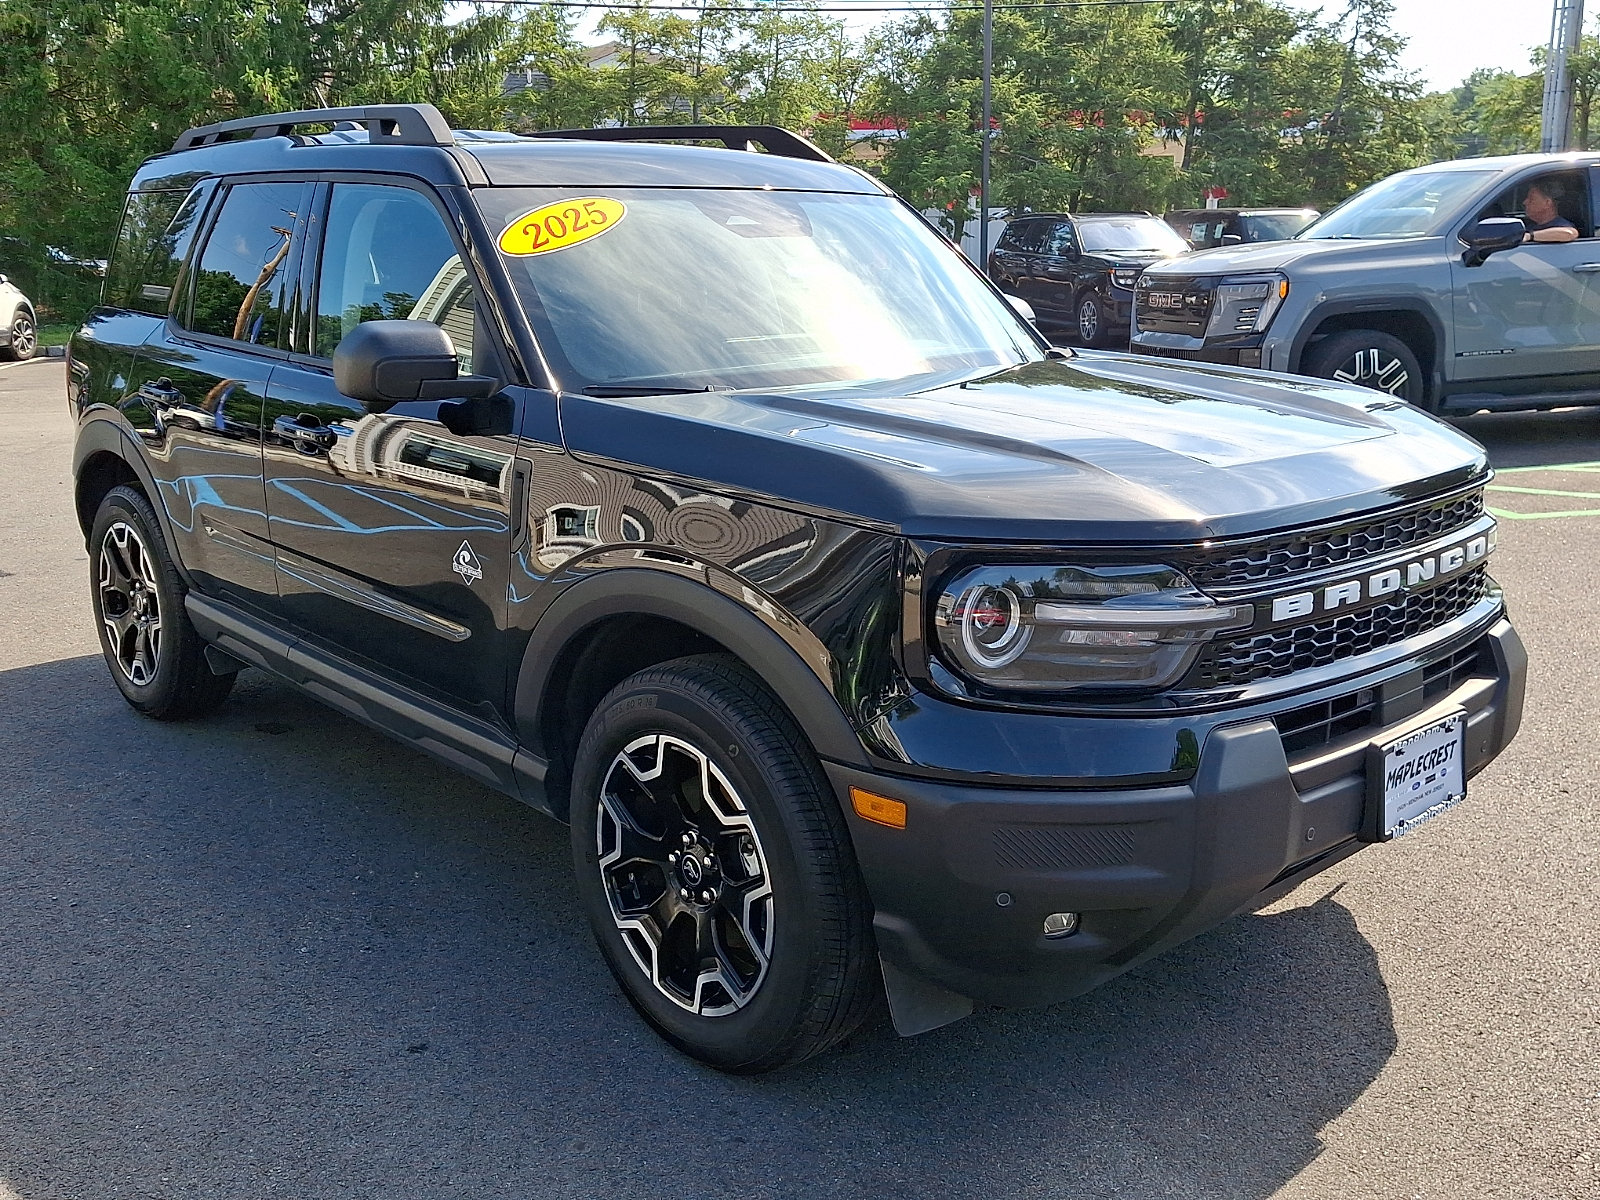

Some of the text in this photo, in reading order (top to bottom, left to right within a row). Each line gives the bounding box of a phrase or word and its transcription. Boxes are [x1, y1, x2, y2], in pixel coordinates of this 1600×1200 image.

[522, 201, 608, 250] 2025
[1149, 292, 1182, 309] GMC
[1271, 536, 1486, 622] BRONCO
[1385, 740, 1458, 792] MAPLECREST
